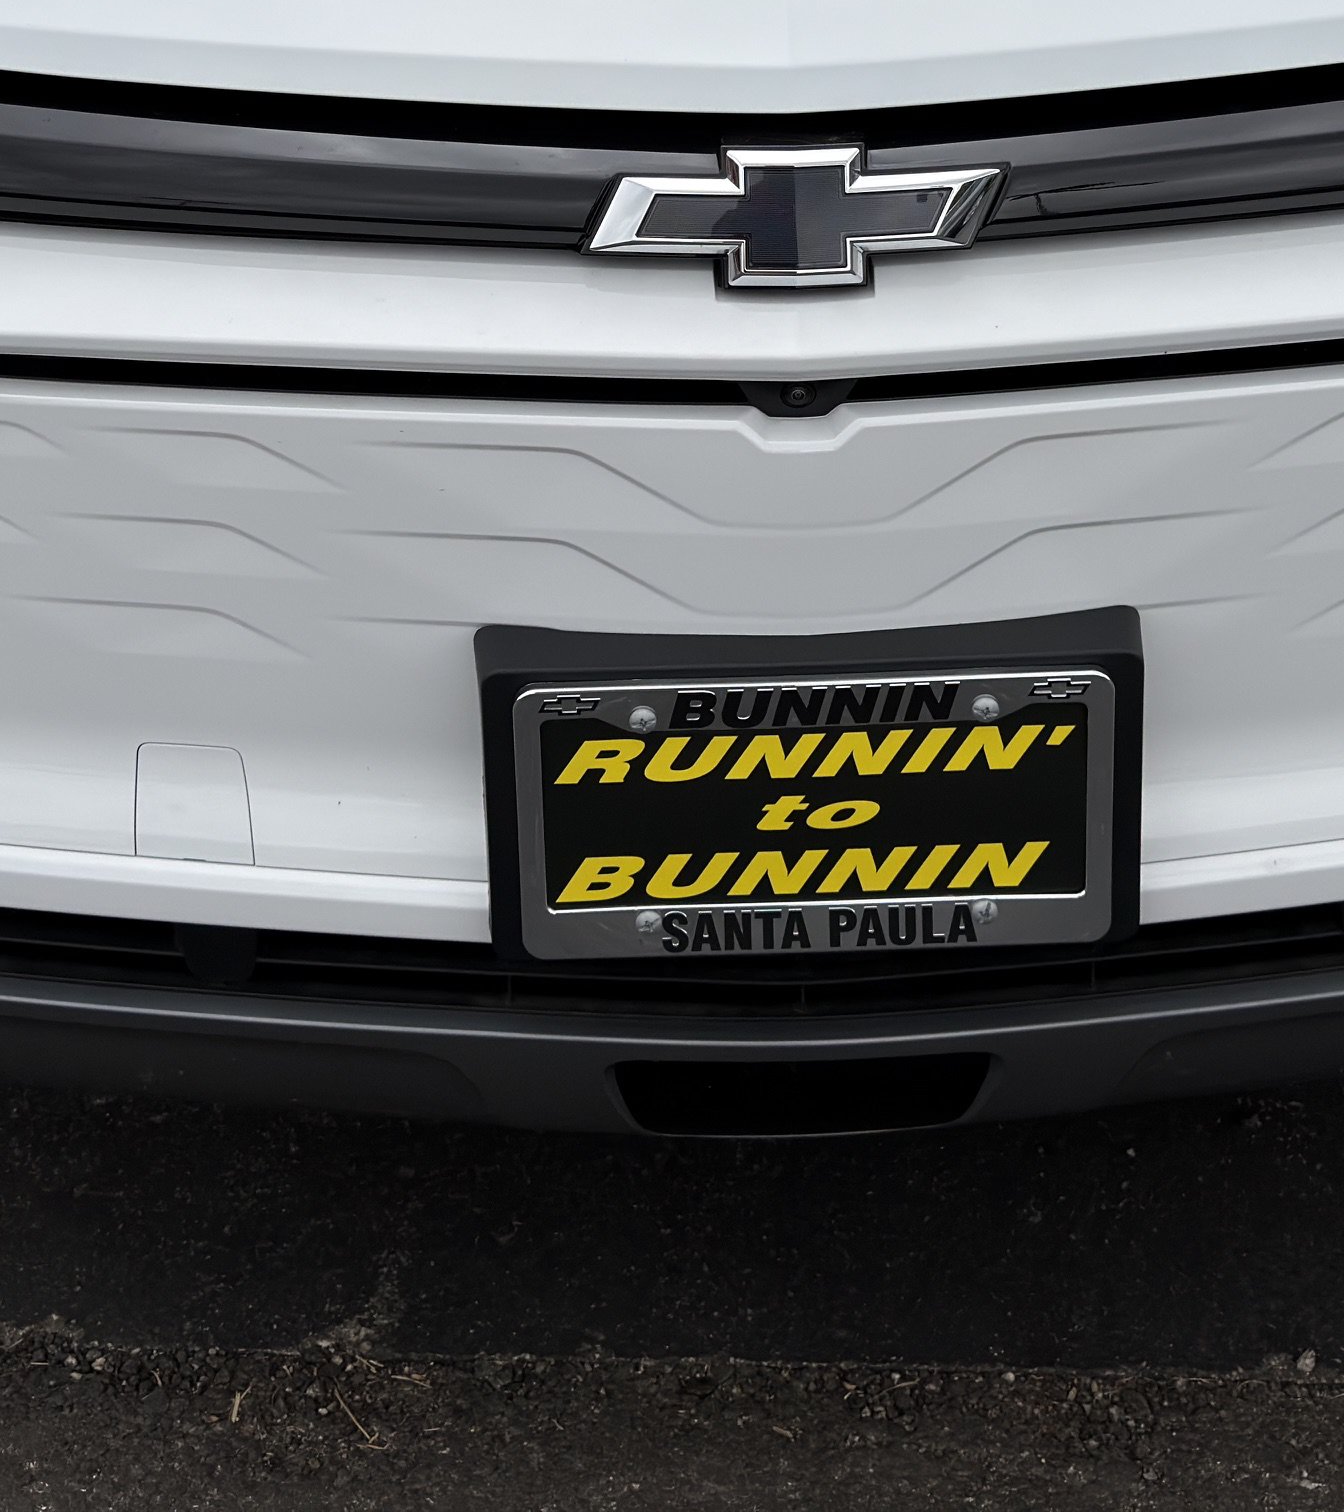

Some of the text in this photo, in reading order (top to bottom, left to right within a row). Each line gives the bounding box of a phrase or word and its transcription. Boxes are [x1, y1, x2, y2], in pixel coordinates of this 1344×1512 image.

[669, 682, 961, 730] BUNNIN
[554, 724, 1076, 785] RUNNIN'
[755, 794, 880, 831] to
[555, 840, 1051, 903] BUNNIN
[661, 902, 978, 953] SANTA PAULA
